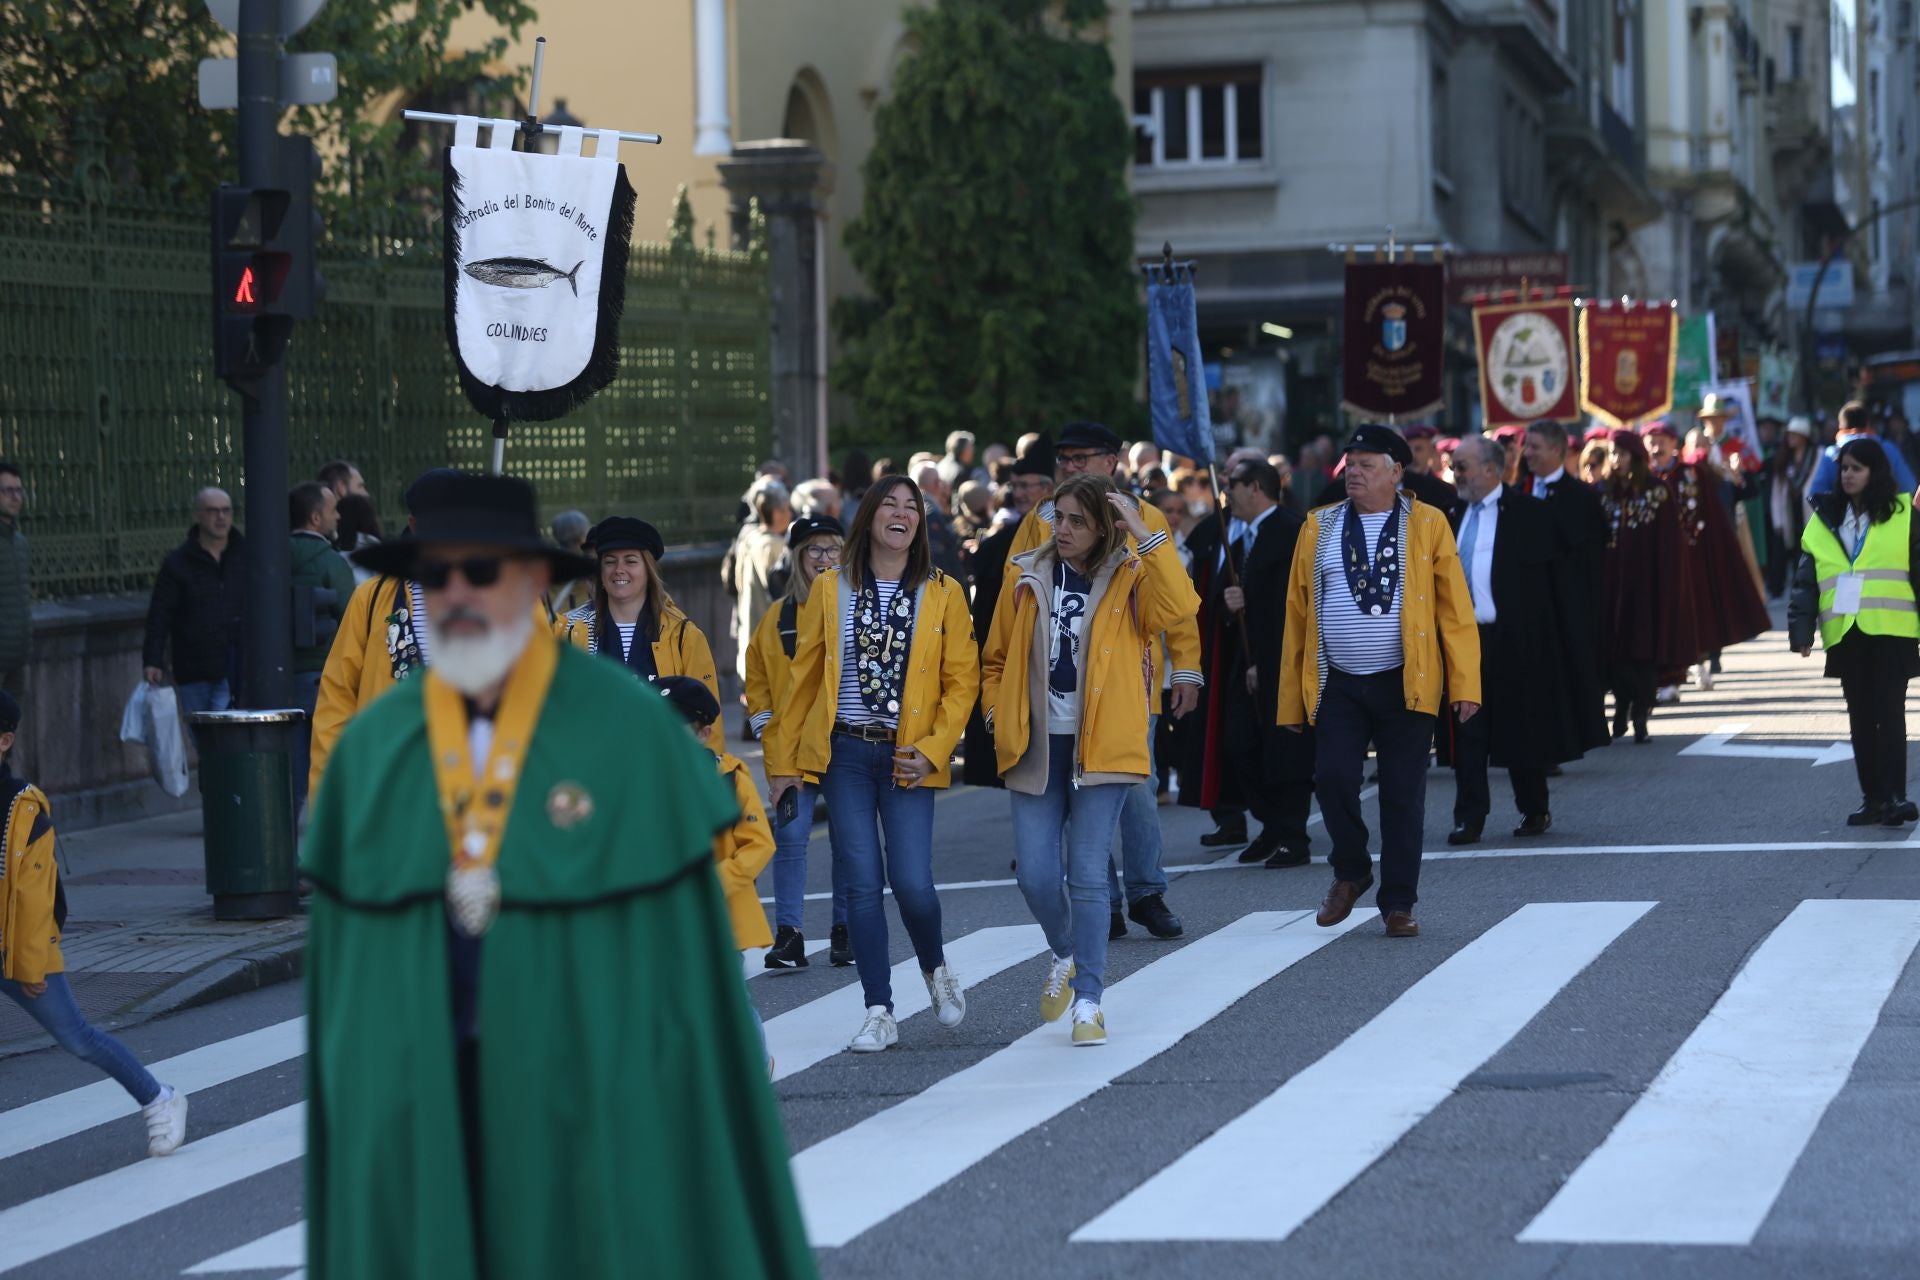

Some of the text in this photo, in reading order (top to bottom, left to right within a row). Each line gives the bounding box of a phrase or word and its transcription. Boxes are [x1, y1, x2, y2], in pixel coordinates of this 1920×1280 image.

[504, 193, 519, 209] del
[525, 194, 555, 212] Bonito
[559, 202, 576, 220] del
[575, 212, 597, 241] Norte
[486, 322, 548, 342] COLINDRES
